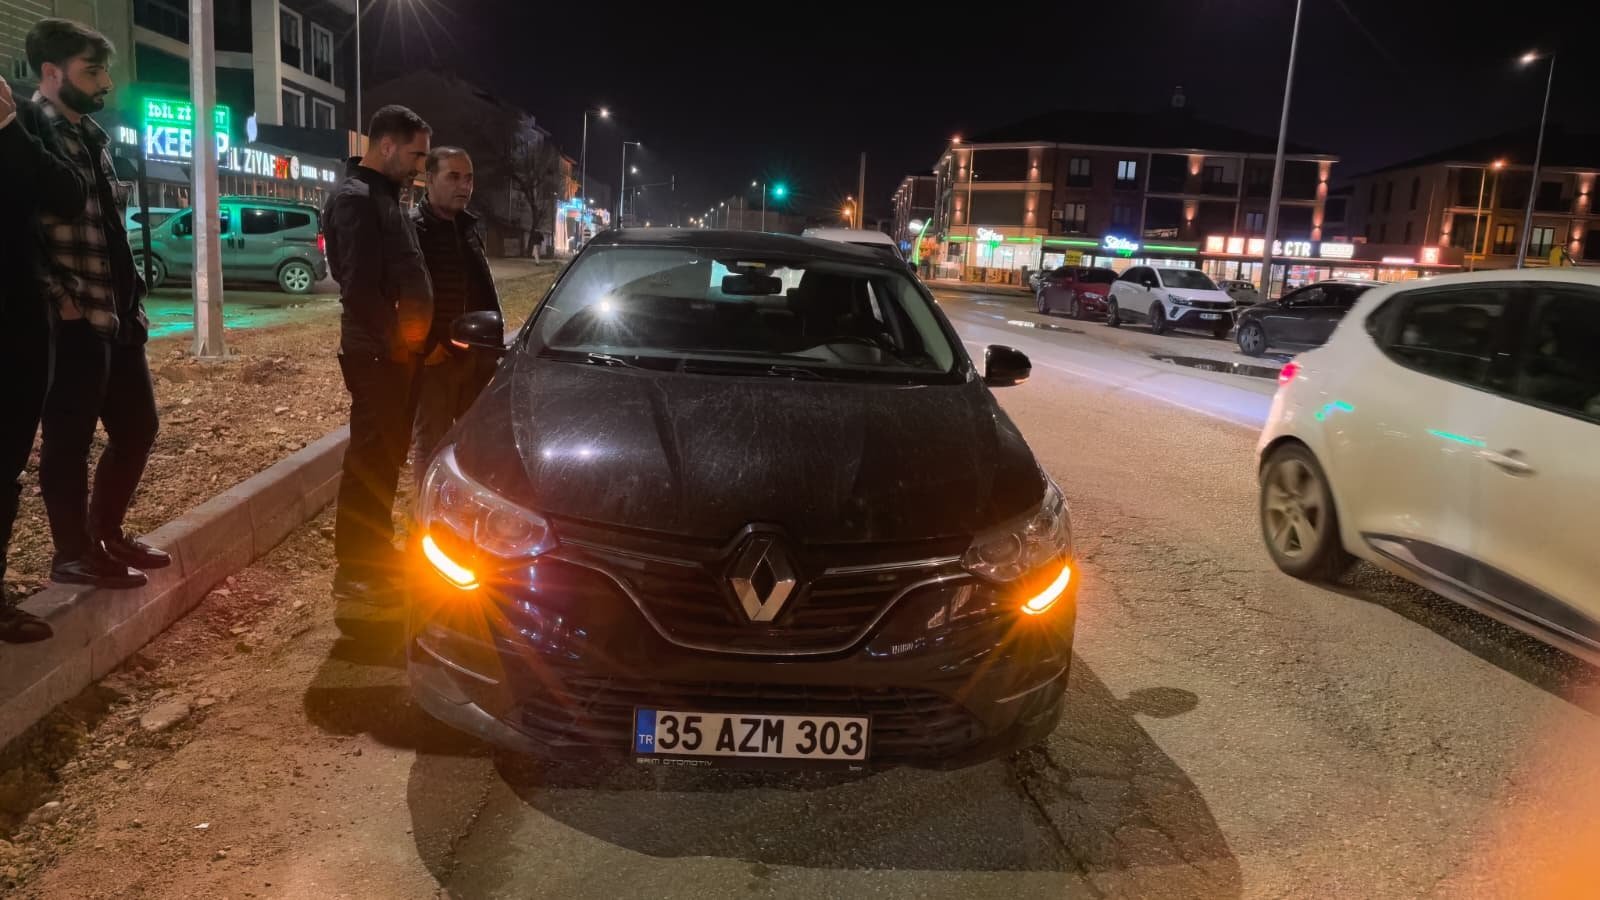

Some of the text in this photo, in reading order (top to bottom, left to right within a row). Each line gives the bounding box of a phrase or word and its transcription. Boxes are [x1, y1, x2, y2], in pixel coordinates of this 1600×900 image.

[147, 125, 228, 160] KEBP
[1285, 241, 1311, 256] CTR
[639, 715, 863, 755] TR 35 AZM 303
